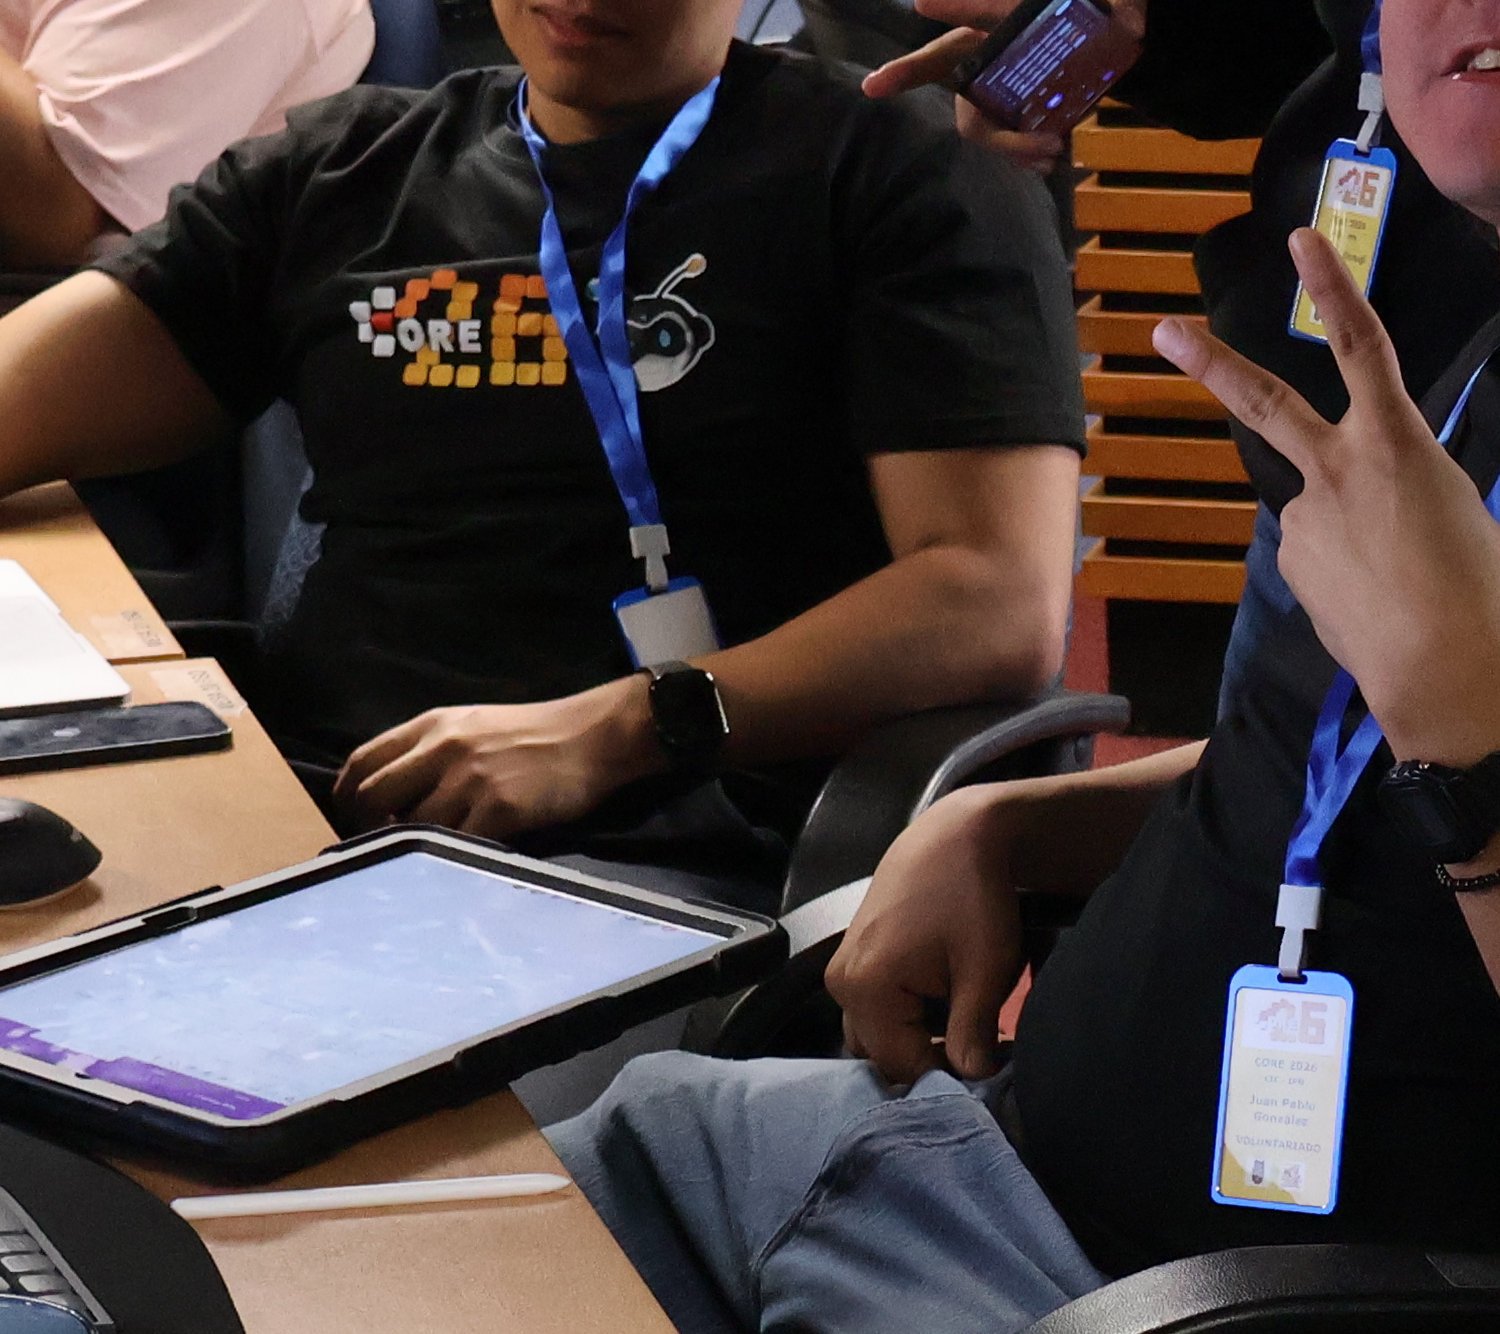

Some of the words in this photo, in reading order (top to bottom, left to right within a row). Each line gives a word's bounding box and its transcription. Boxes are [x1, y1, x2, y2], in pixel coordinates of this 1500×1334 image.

[350, 286, 482, 358] CORE
[1254, 1057, 1285, 1069] CORE
[1290, 1059, 1318, 1072] 2026
[1250, 1094, 1278, 1107] Juan
[1282, 1096, 1316, 1111] Pablo
[1235, 1134, 1322, 1153] VOLUNTARIADO
